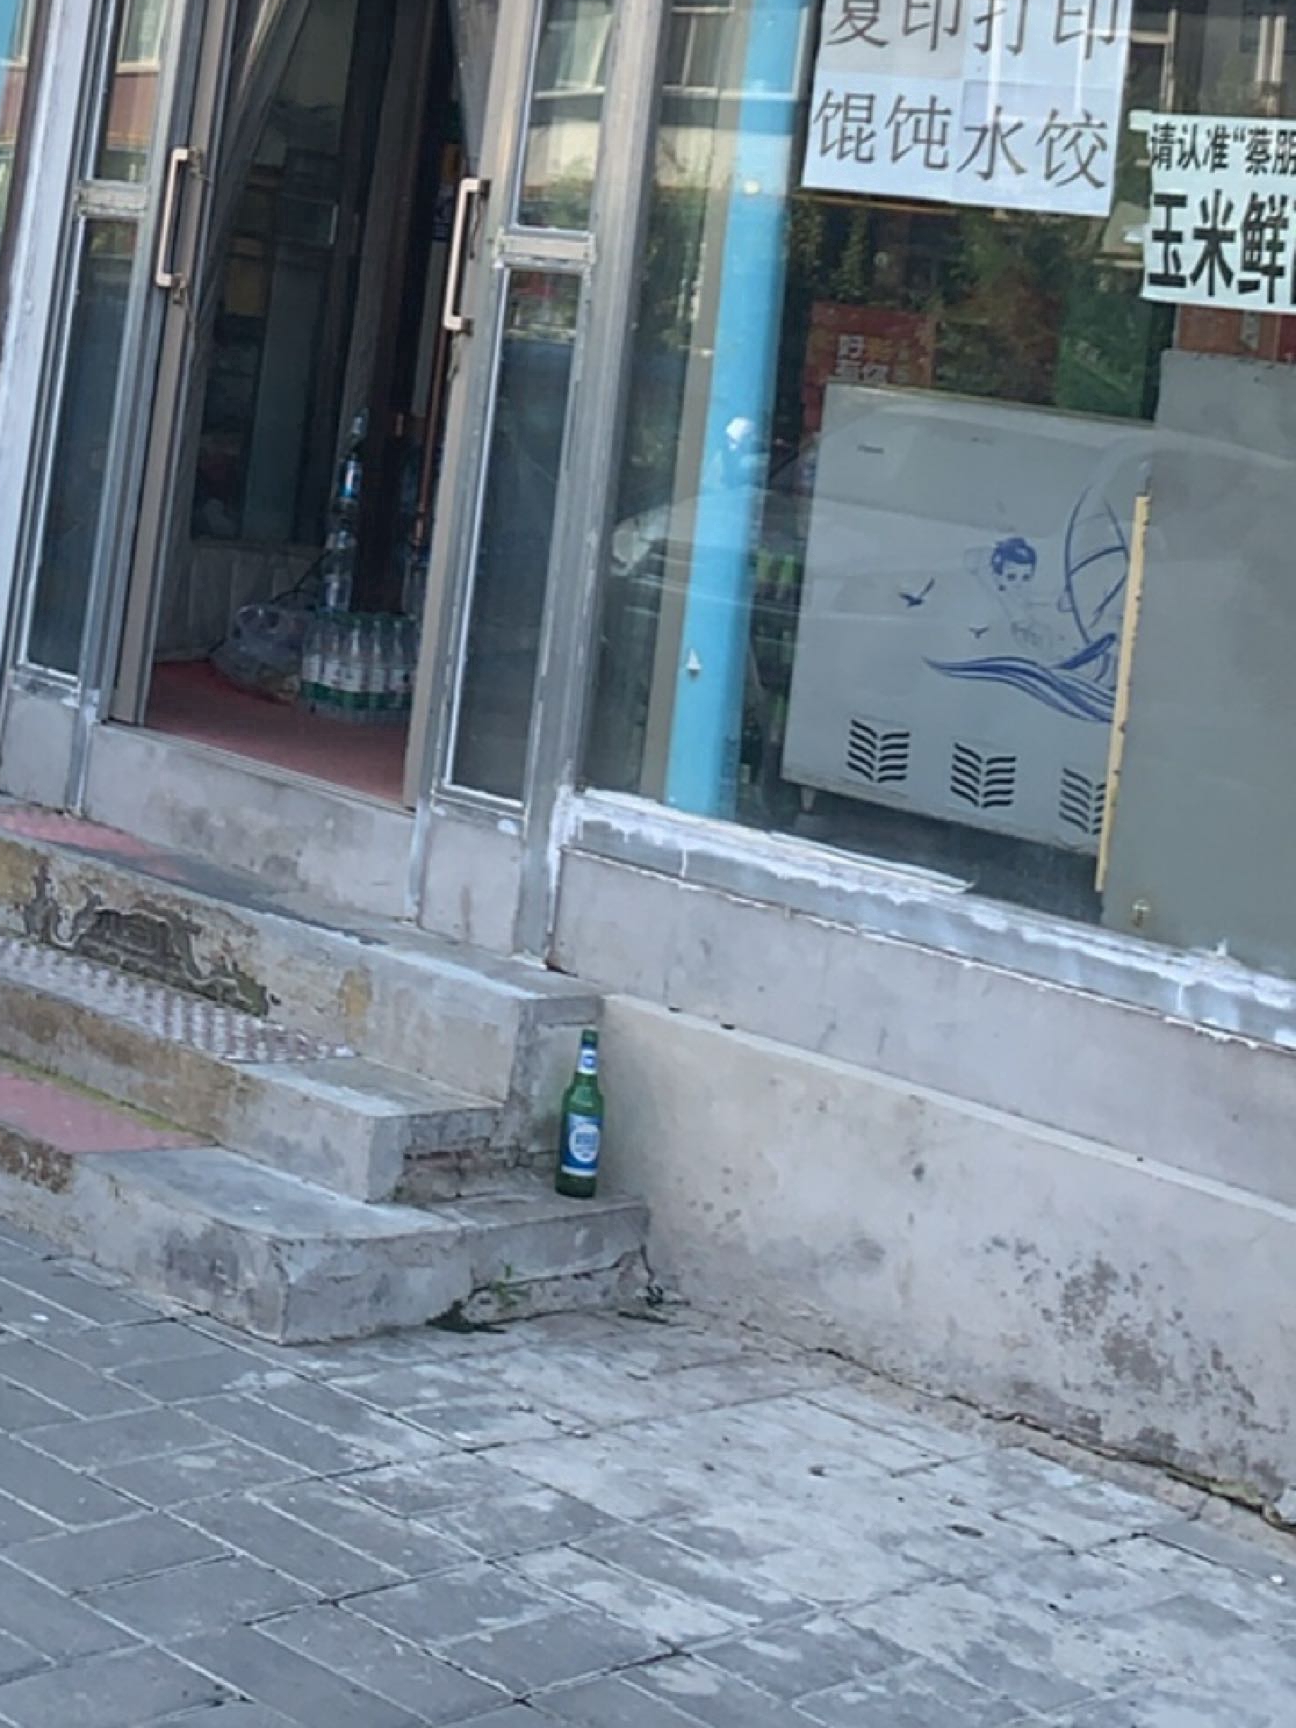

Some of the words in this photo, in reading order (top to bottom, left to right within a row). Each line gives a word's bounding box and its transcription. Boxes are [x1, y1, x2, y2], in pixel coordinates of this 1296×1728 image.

[812, 89, 1109, 189] 馄饨水饺
[1147, 189, 1296, 304] 玉米鲜
